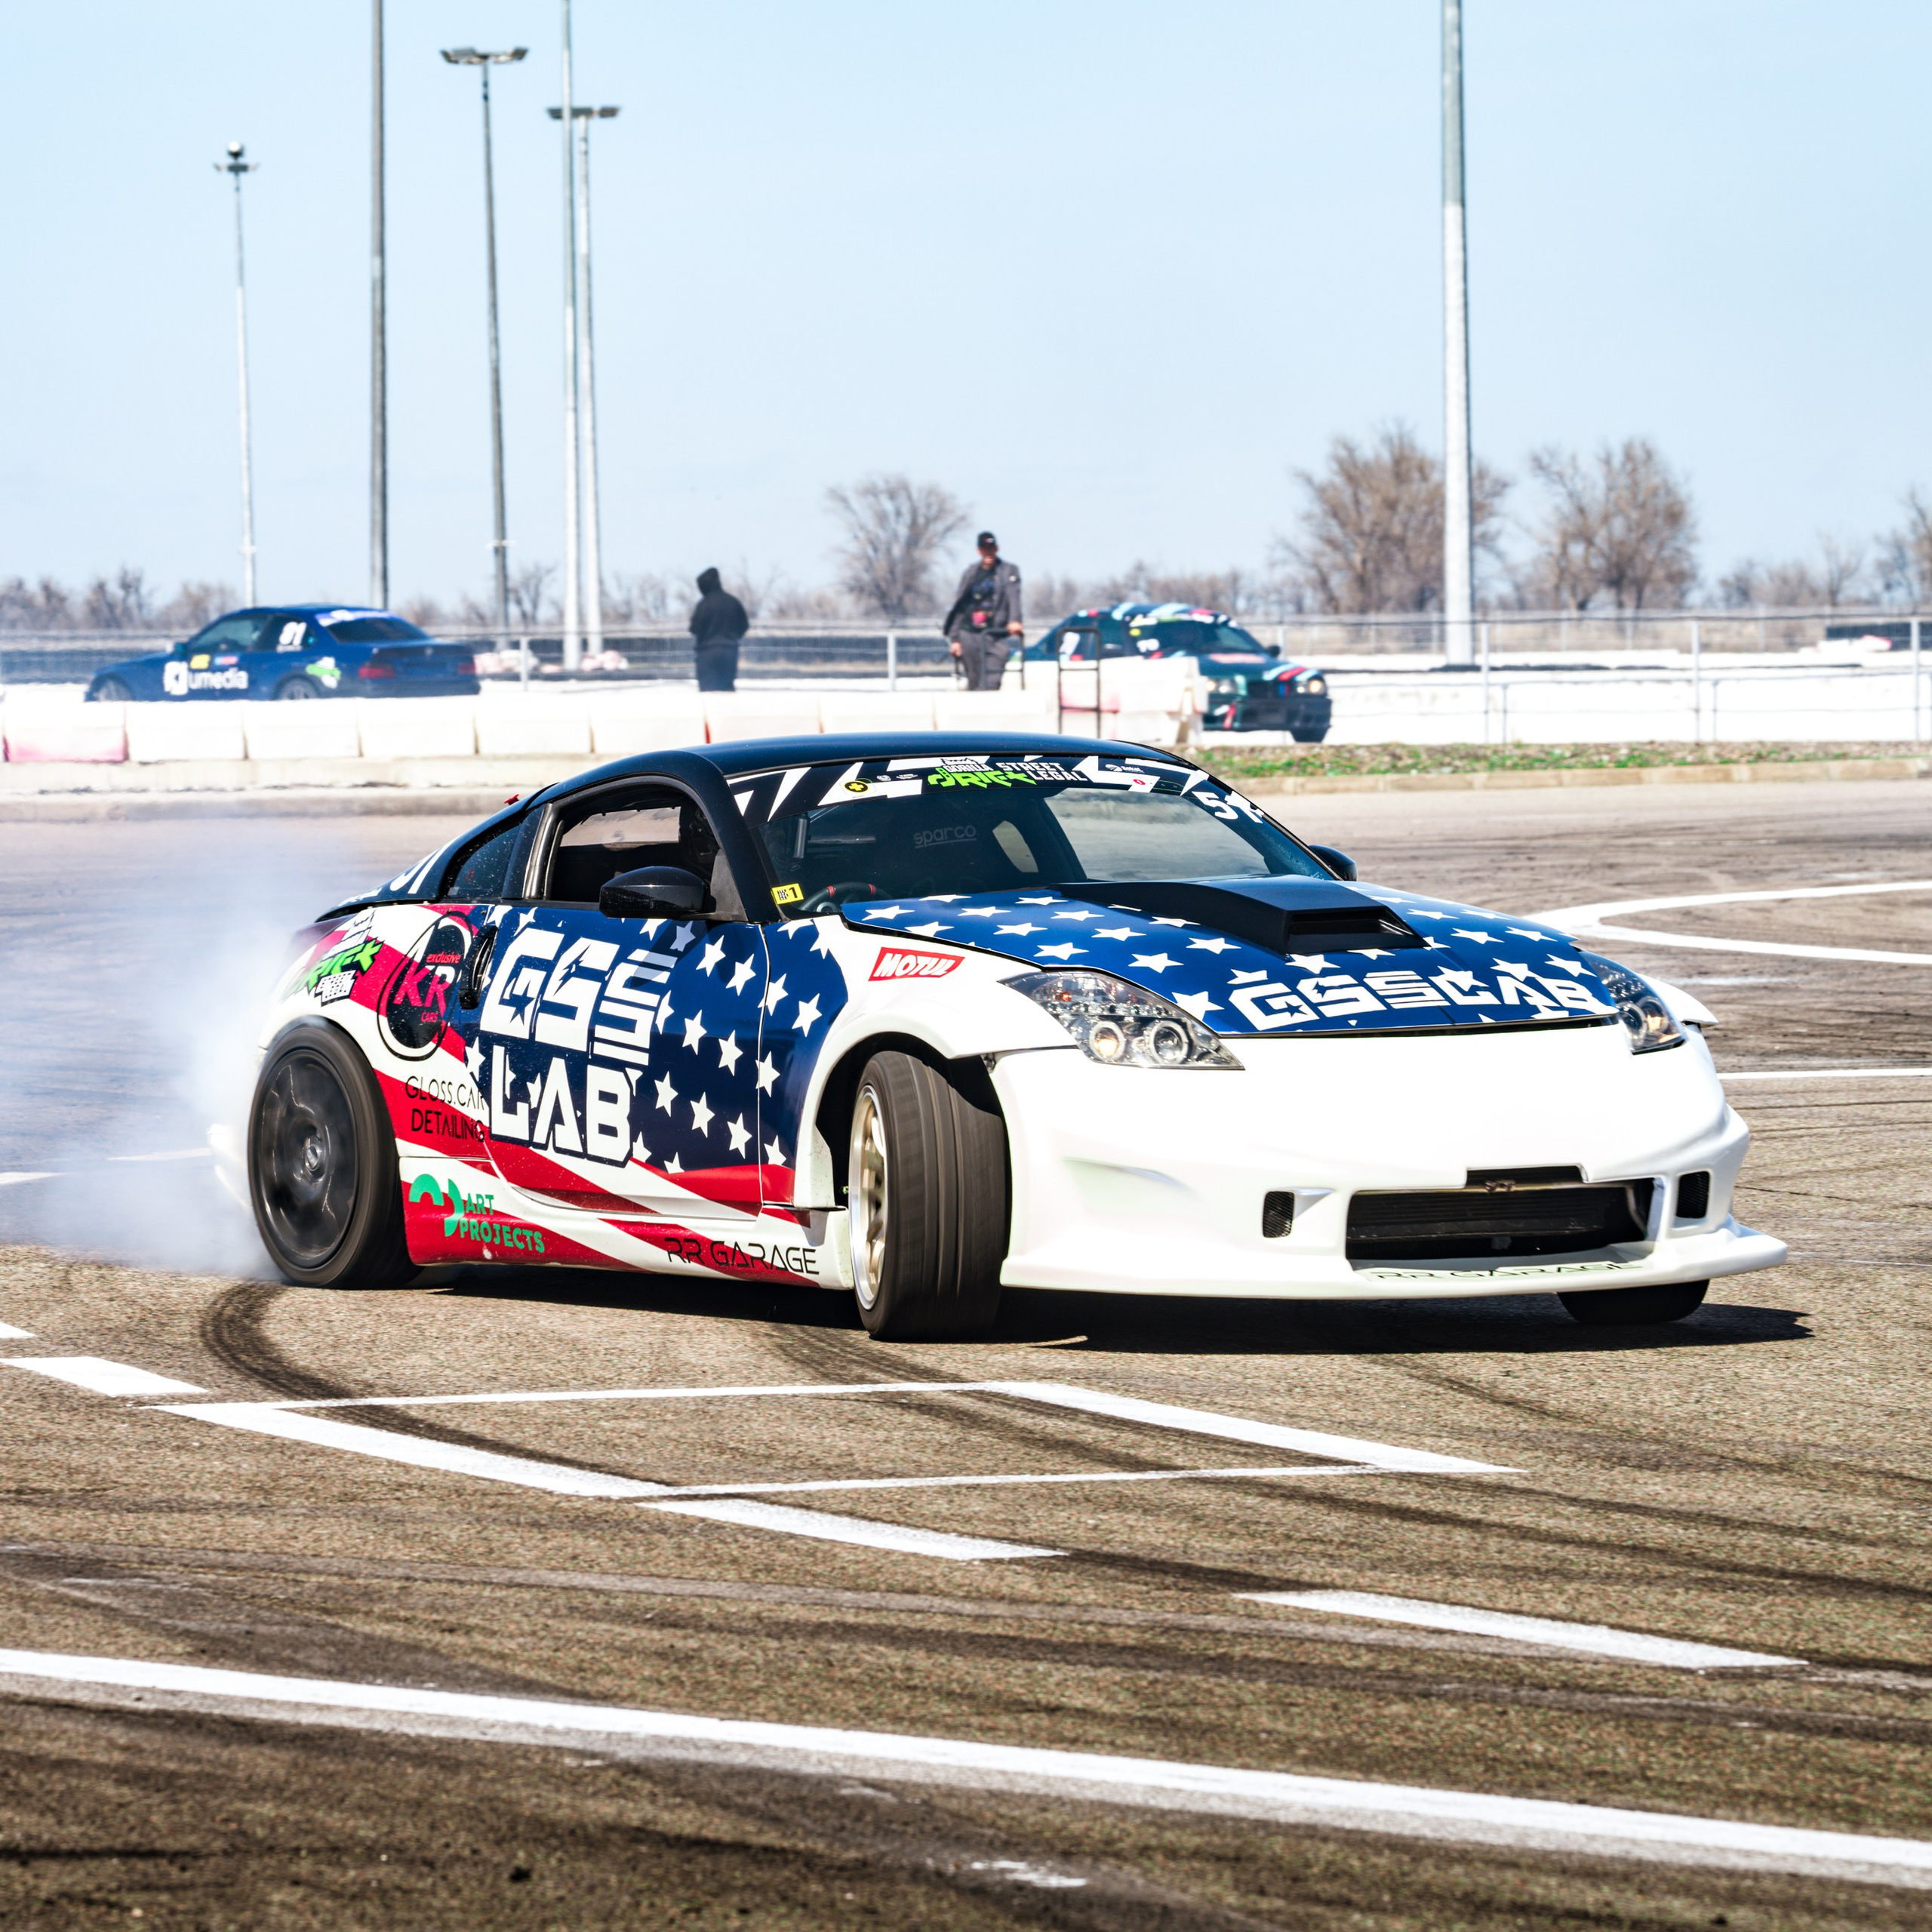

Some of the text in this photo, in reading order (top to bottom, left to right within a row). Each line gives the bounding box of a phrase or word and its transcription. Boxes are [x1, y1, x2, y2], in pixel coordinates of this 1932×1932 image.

[943, 764, 994, 773] GORILLA
[995, 762, 1065, 771] STREET
[1026, 771, 1088, 781] LEGAL
[914, 825, 977, 848] sparco
[426, 951, 462, 964] exclusive
[873, 952, 956, 977] MOTUL
[392, 962, 456, 1016] KR
[480, 928, 678, 1066] GSS
[421, 1012, 438, 1023] CARS
[492, 1045, 630, 1161] LAB
[411, 1109, 485, 1143] DETAILING
[464, 1193, 494, 1215] ART
[460, 1217, 545, 1253] PROJECTS
[665, 1238, 820, 1275] RR GARAGE
